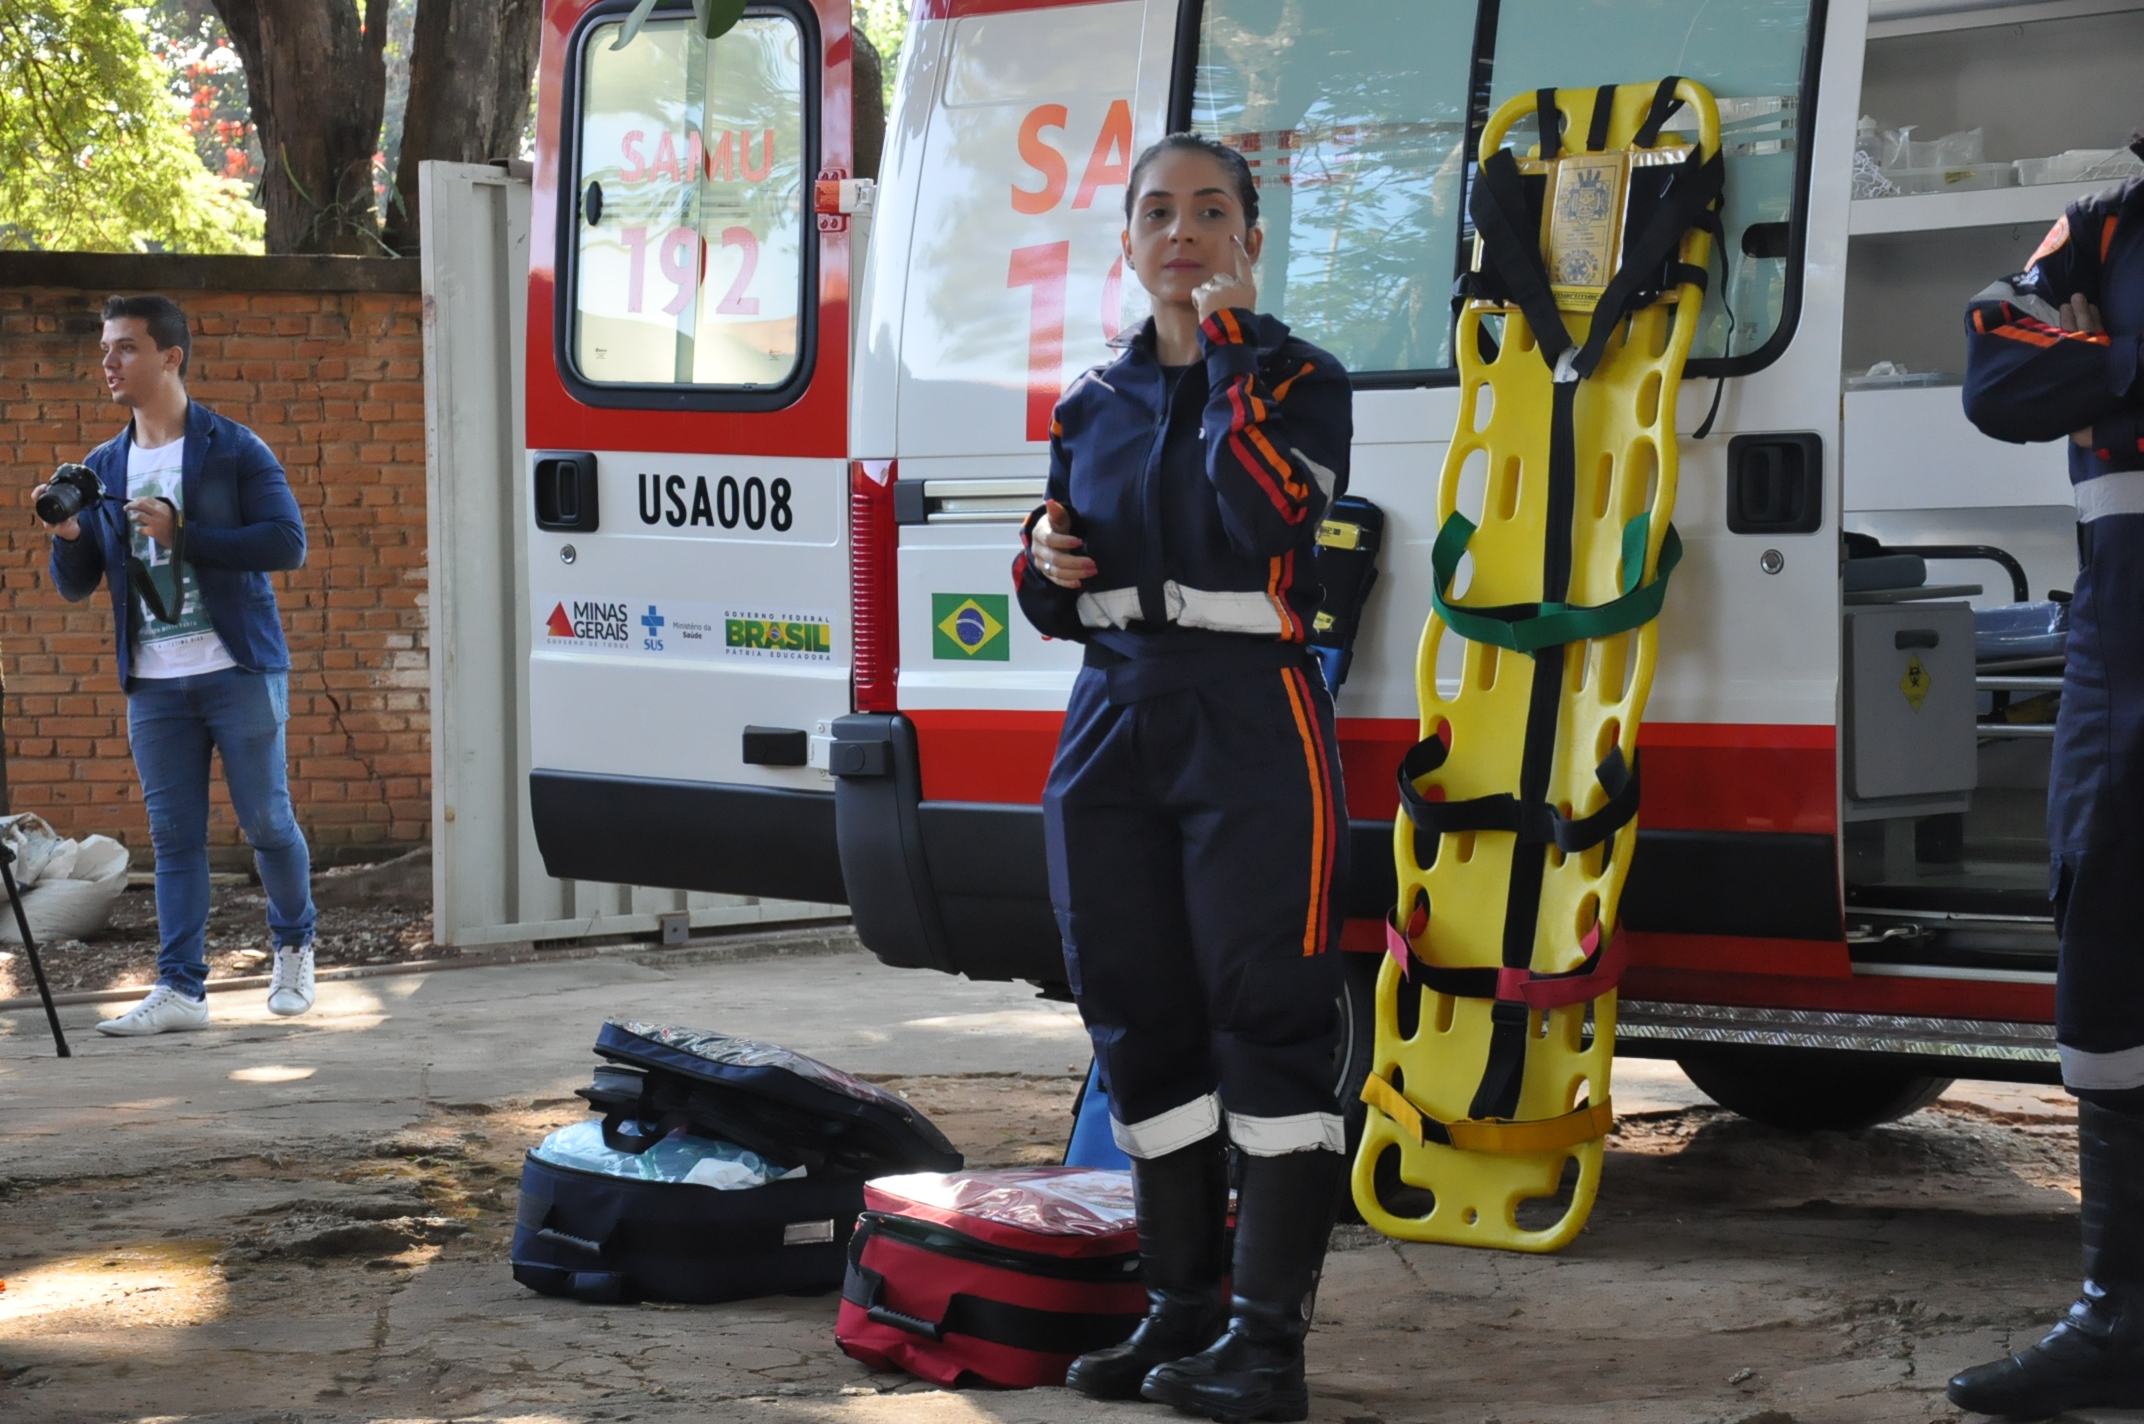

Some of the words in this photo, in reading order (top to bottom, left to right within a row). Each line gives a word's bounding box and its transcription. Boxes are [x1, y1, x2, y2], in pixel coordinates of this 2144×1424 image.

[619, 130, 775, 183] SAMU
[621, 226, 760, 316] 192
[638, 473, 793, 532] USA008
[573, 601, 628, 623] MINAS
[724, 610, 774, 620] GOVERNO
[782, 613, 830, 623] FEDERAL
[573, 620, 629, 641] GERAIS
[672, 621, 702, 631] Ministério
[703, 623, 712, 632] da
[546, 638, 584, 646] GOVERNO
[603, 641, 629, 649] TODOS
[682, 631, 702, 640] Saúde
[725, 619, 831, 653] BRASIL
[643, 638, 664, 651] SUS
[725, 648, 762, 657] PÁTRIA
[769, 650, 831, 661] EDUCADORA
